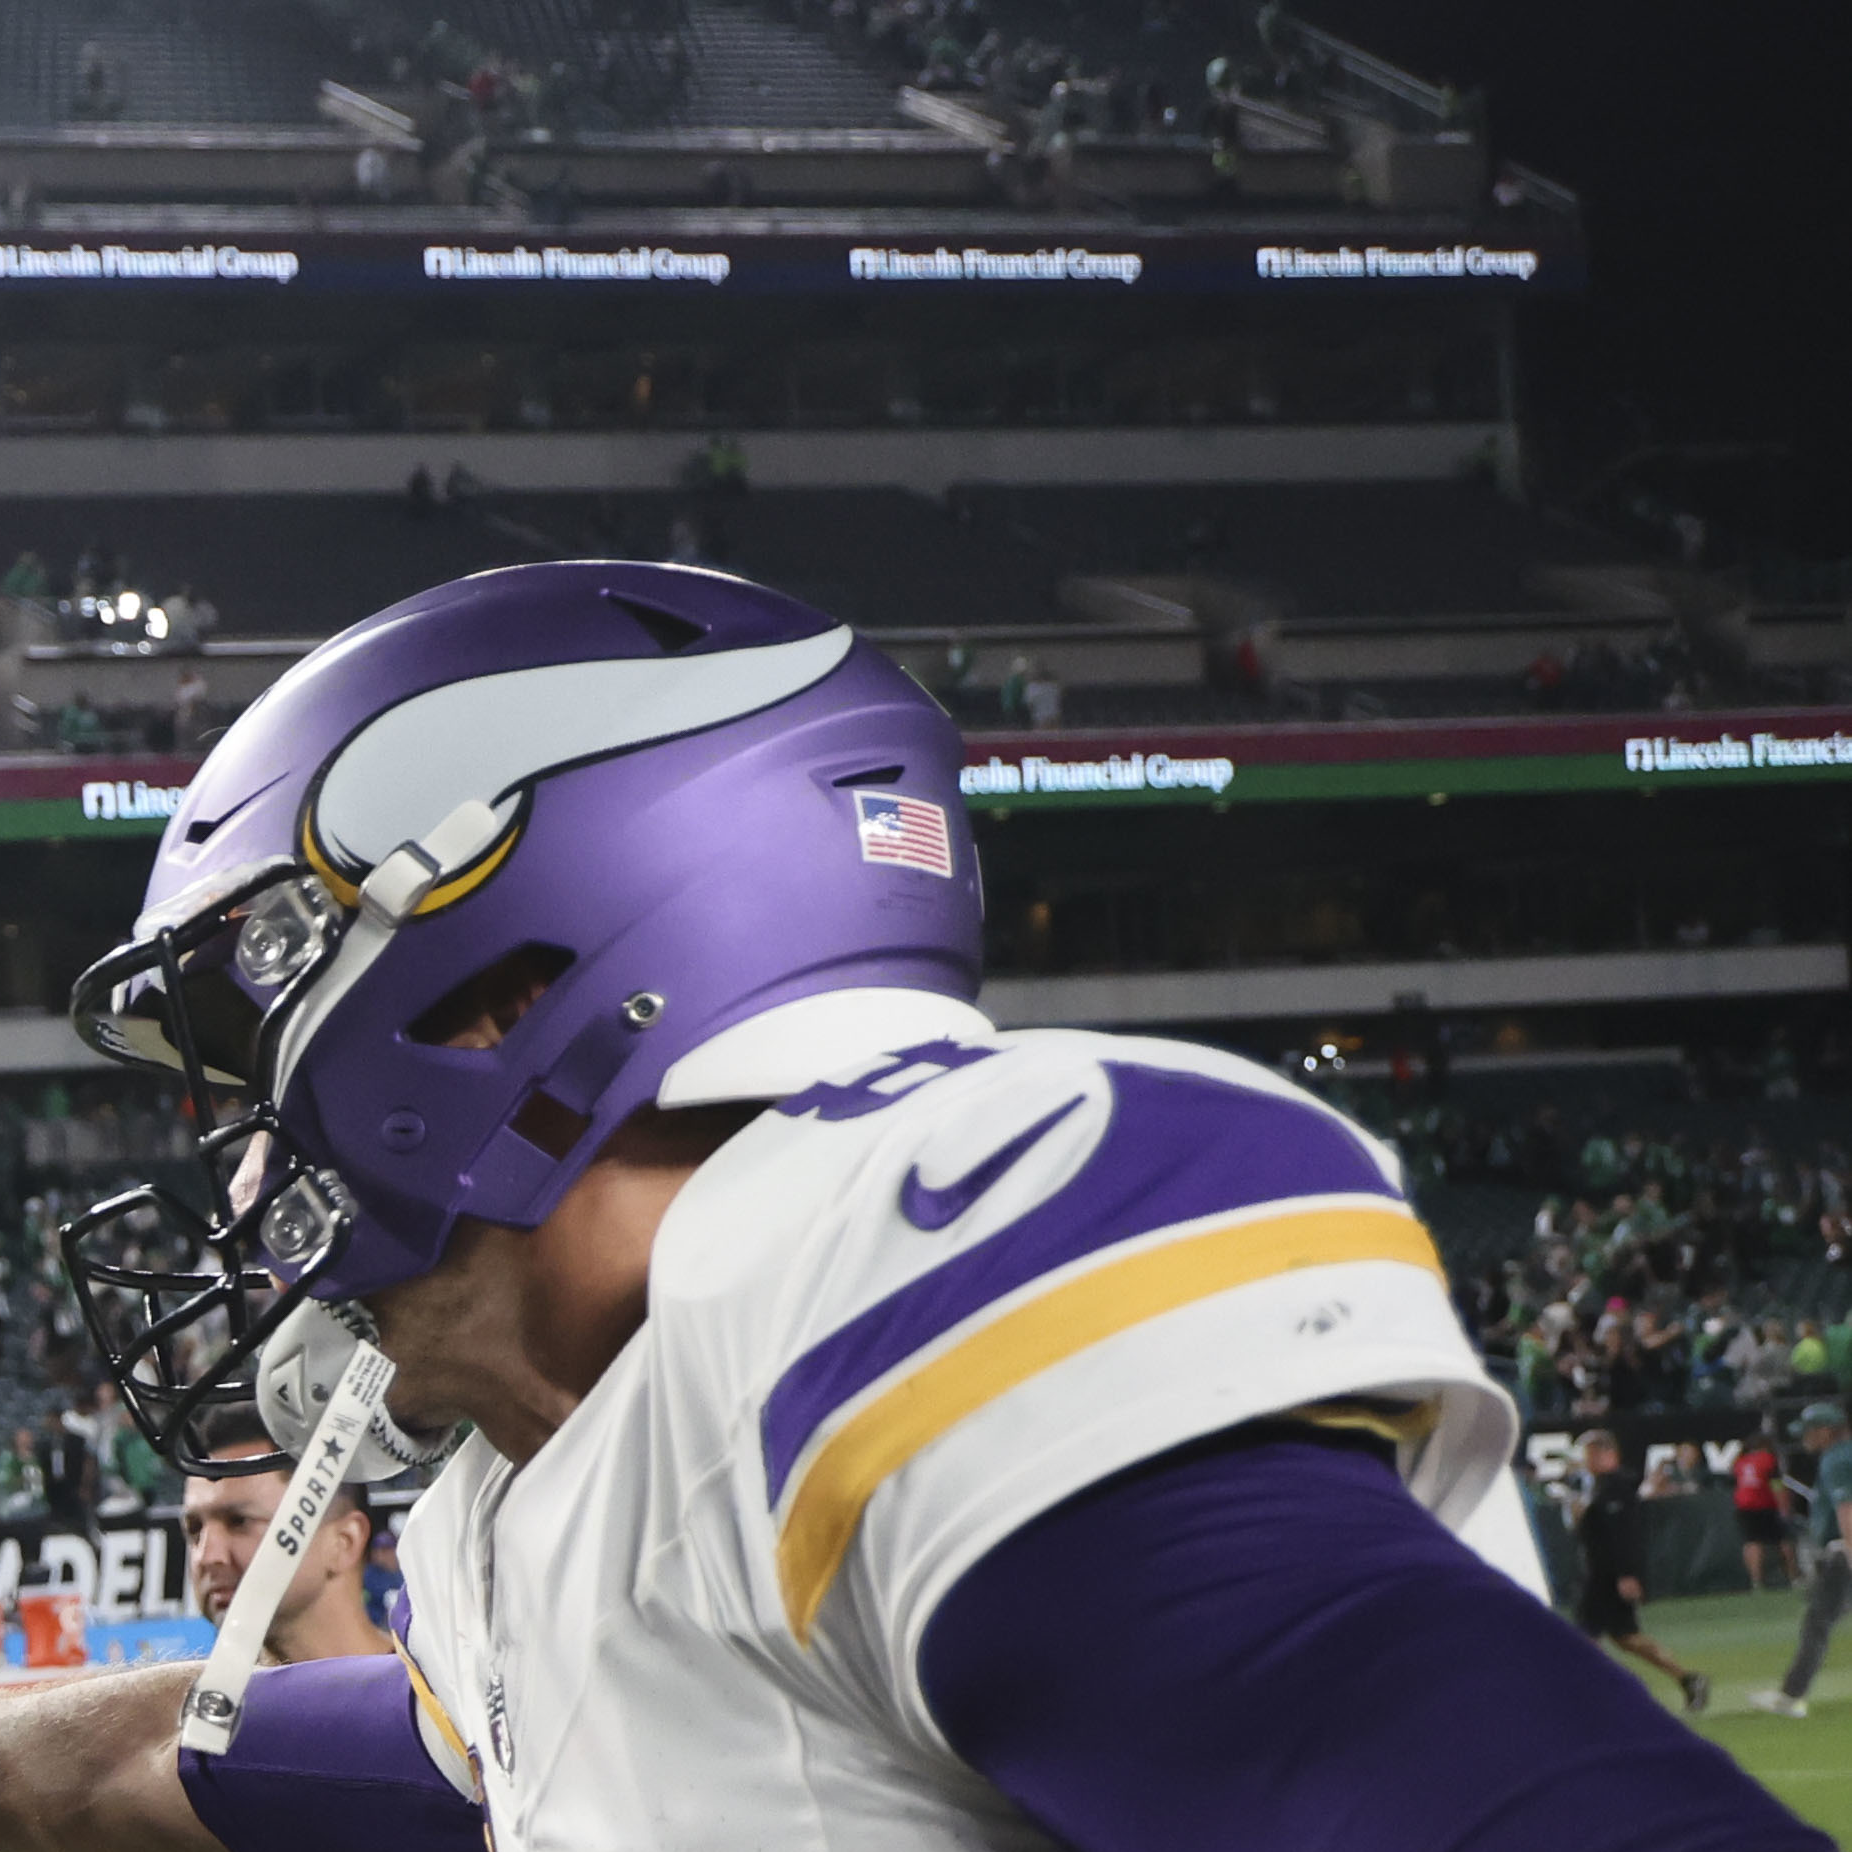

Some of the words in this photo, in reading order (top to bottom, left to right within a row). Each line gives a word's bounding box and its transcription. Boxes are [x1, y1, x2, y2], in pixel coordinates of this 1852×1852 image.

[4, 244, 101, 278] Lincoln
[101, 244, 216, 279] Financial
[216, 245, 299, 284] Group
[652, 247, 730, 286] Group
[1067, 247, 1143, 285] Group
[1465, 246, 1537, 281] Group
[1654, 732, 1750, 771] Lincoln
[1021, 752, 1146, 793] Financial
[1146, 754, 1234, 794] Group
[116, 780, 185, 819] Linc
[276, 1457, 336, 1557] SPORT
